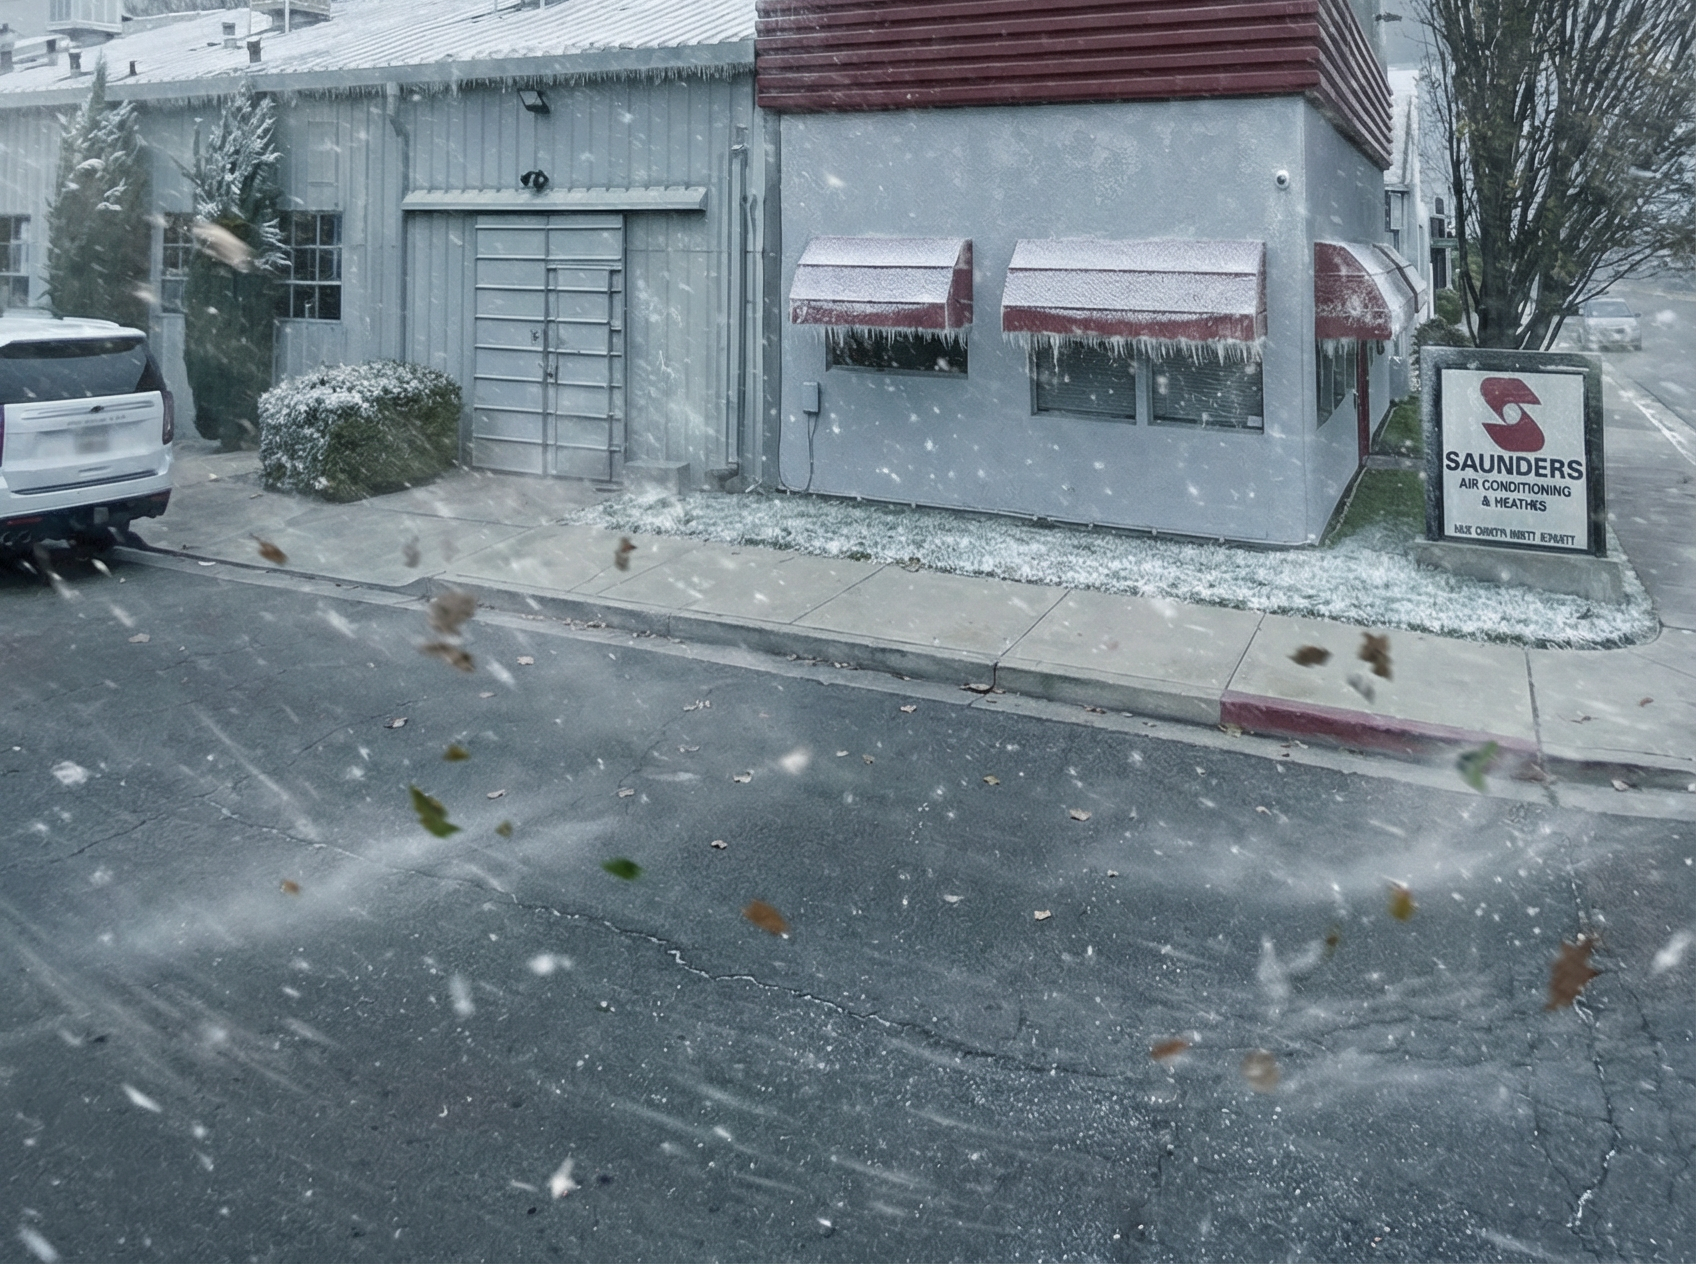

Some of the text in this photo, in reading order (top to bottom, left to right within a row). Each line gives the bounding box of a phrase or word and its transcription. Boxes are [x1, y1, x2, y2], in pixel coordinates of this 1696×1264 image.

[1445, 451, 1584, 480] SAUNDERS
[1459, 478, 1572, 497] AIR CONDITIONING
